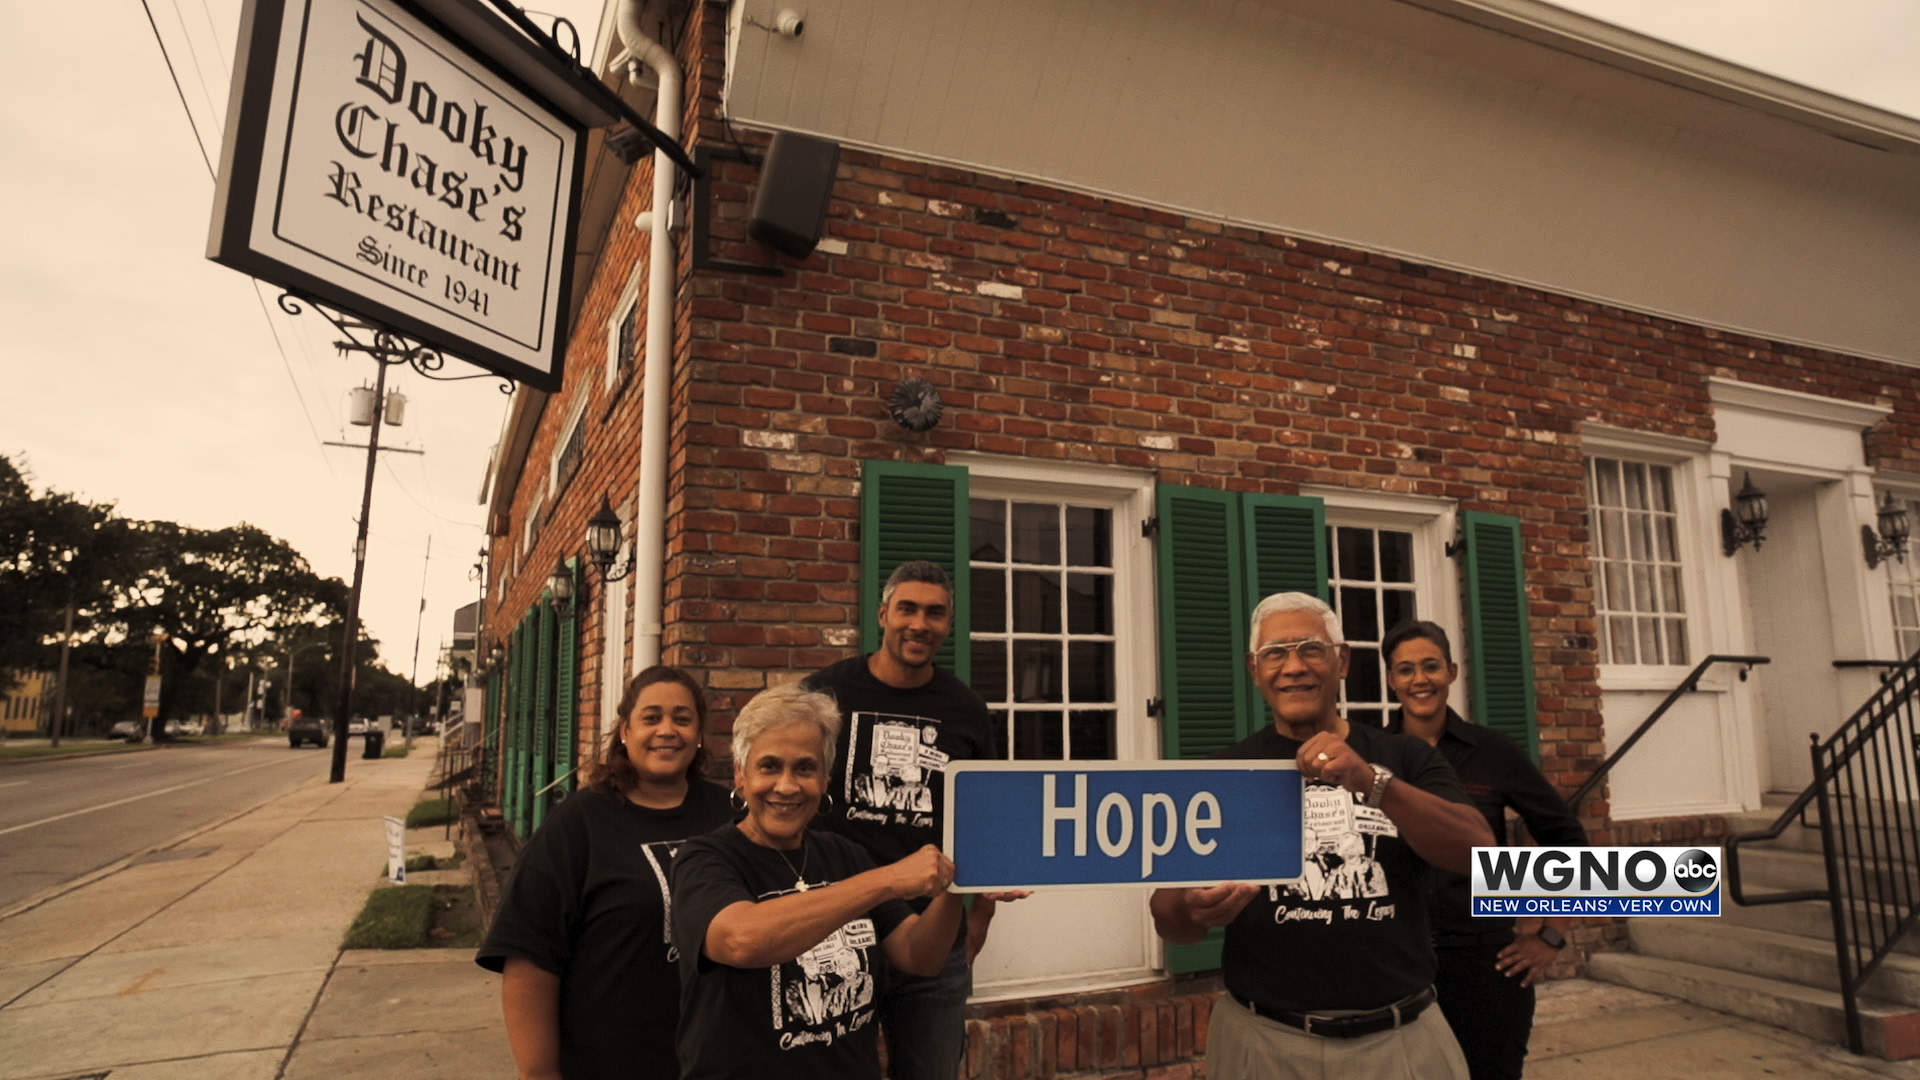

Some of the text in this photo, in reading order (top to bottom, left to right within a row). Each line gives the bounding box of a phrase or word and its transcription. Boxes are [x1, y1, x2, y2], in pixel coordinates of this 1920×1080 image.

[353, 10, 528, 192] Dooky
[324, 160, 521, 290] Restaurant
[335, 101, 526, 242] Chase's
[356, 235, 489, 316] Since 1941
[1042, 773, 1222, 879] Hope
